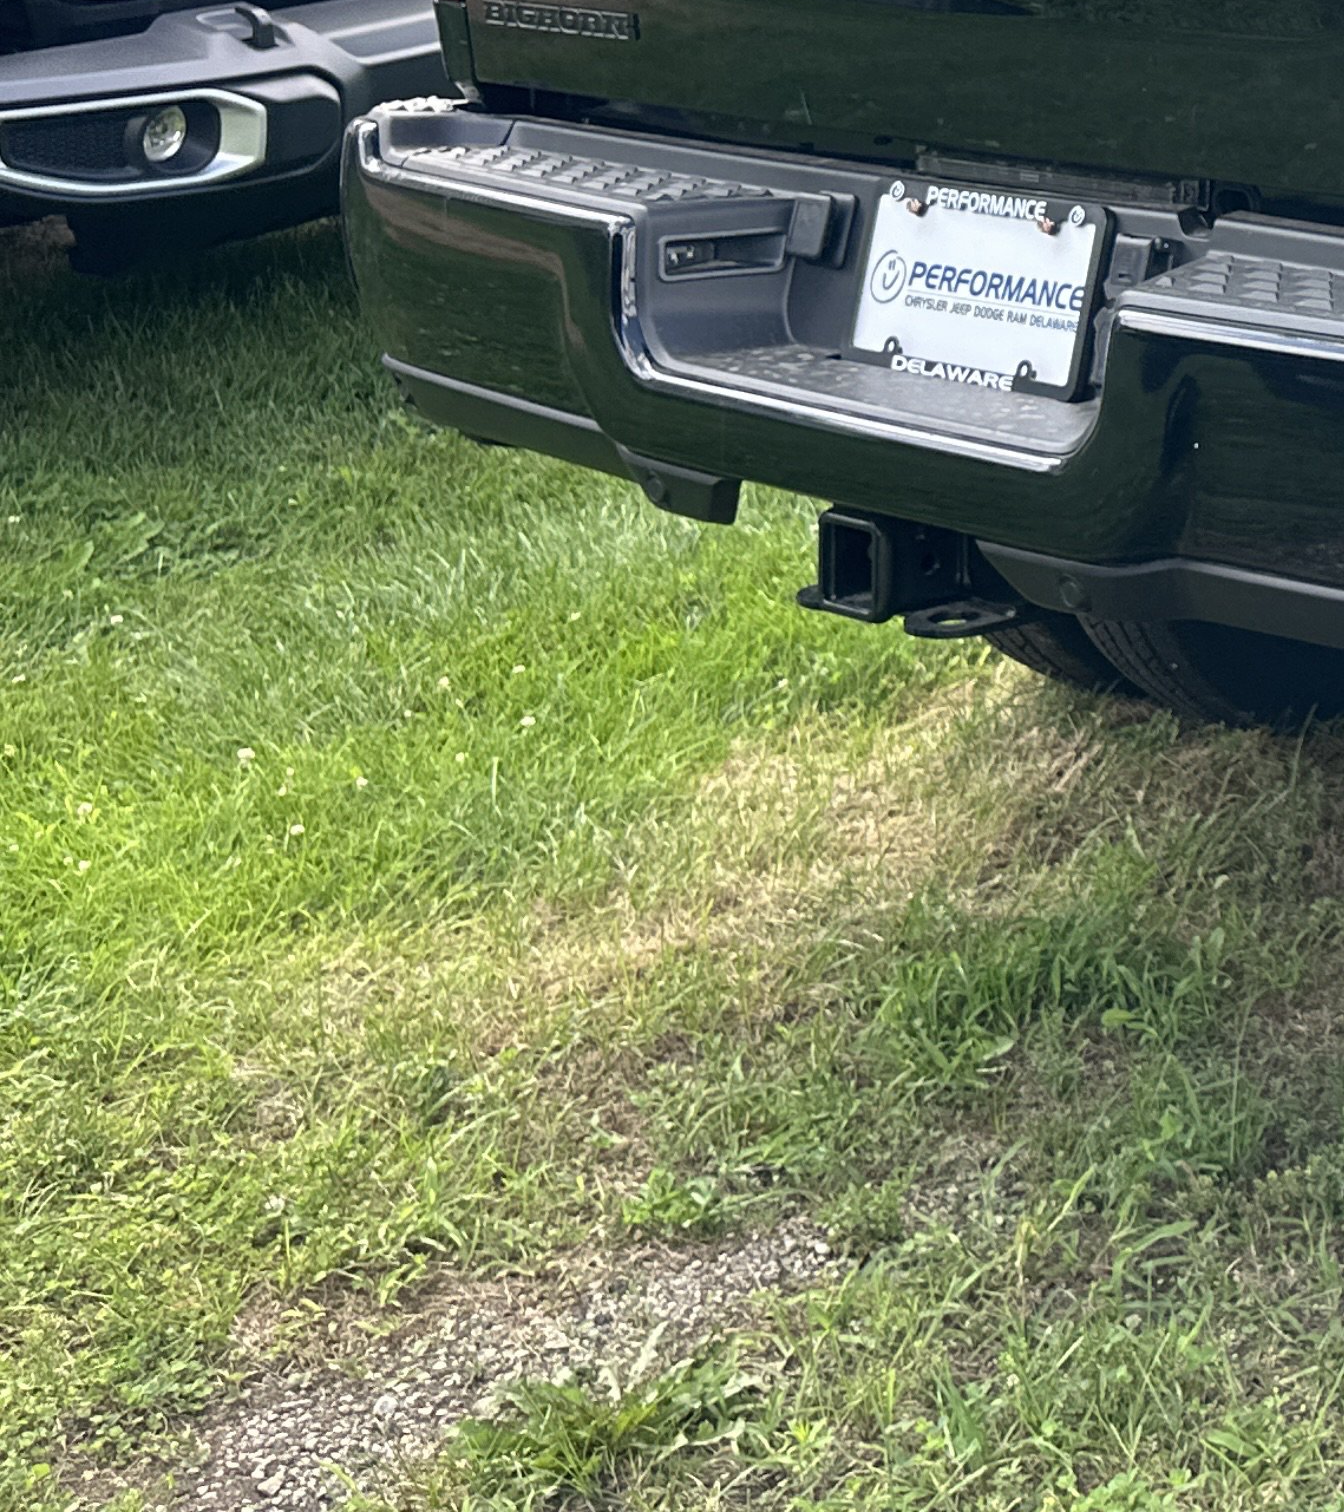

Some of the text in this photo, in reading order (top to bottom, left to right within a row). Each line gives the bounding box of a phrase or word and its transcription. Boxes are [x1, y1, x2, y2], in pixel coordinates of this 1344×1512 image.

[926, 186, 1048, 220] PERFORMANCE
[908, 261, 1086, 311] PERFORMANCE
[904, 294, 948, 312] CHRYSLER
[949, 302, 972, 315] JEEP
[973, 305, 1005, 322] DODGE
[1006, 310, 1028, 325] RAM
[891, 354, 1014, 391] DELAWARE
